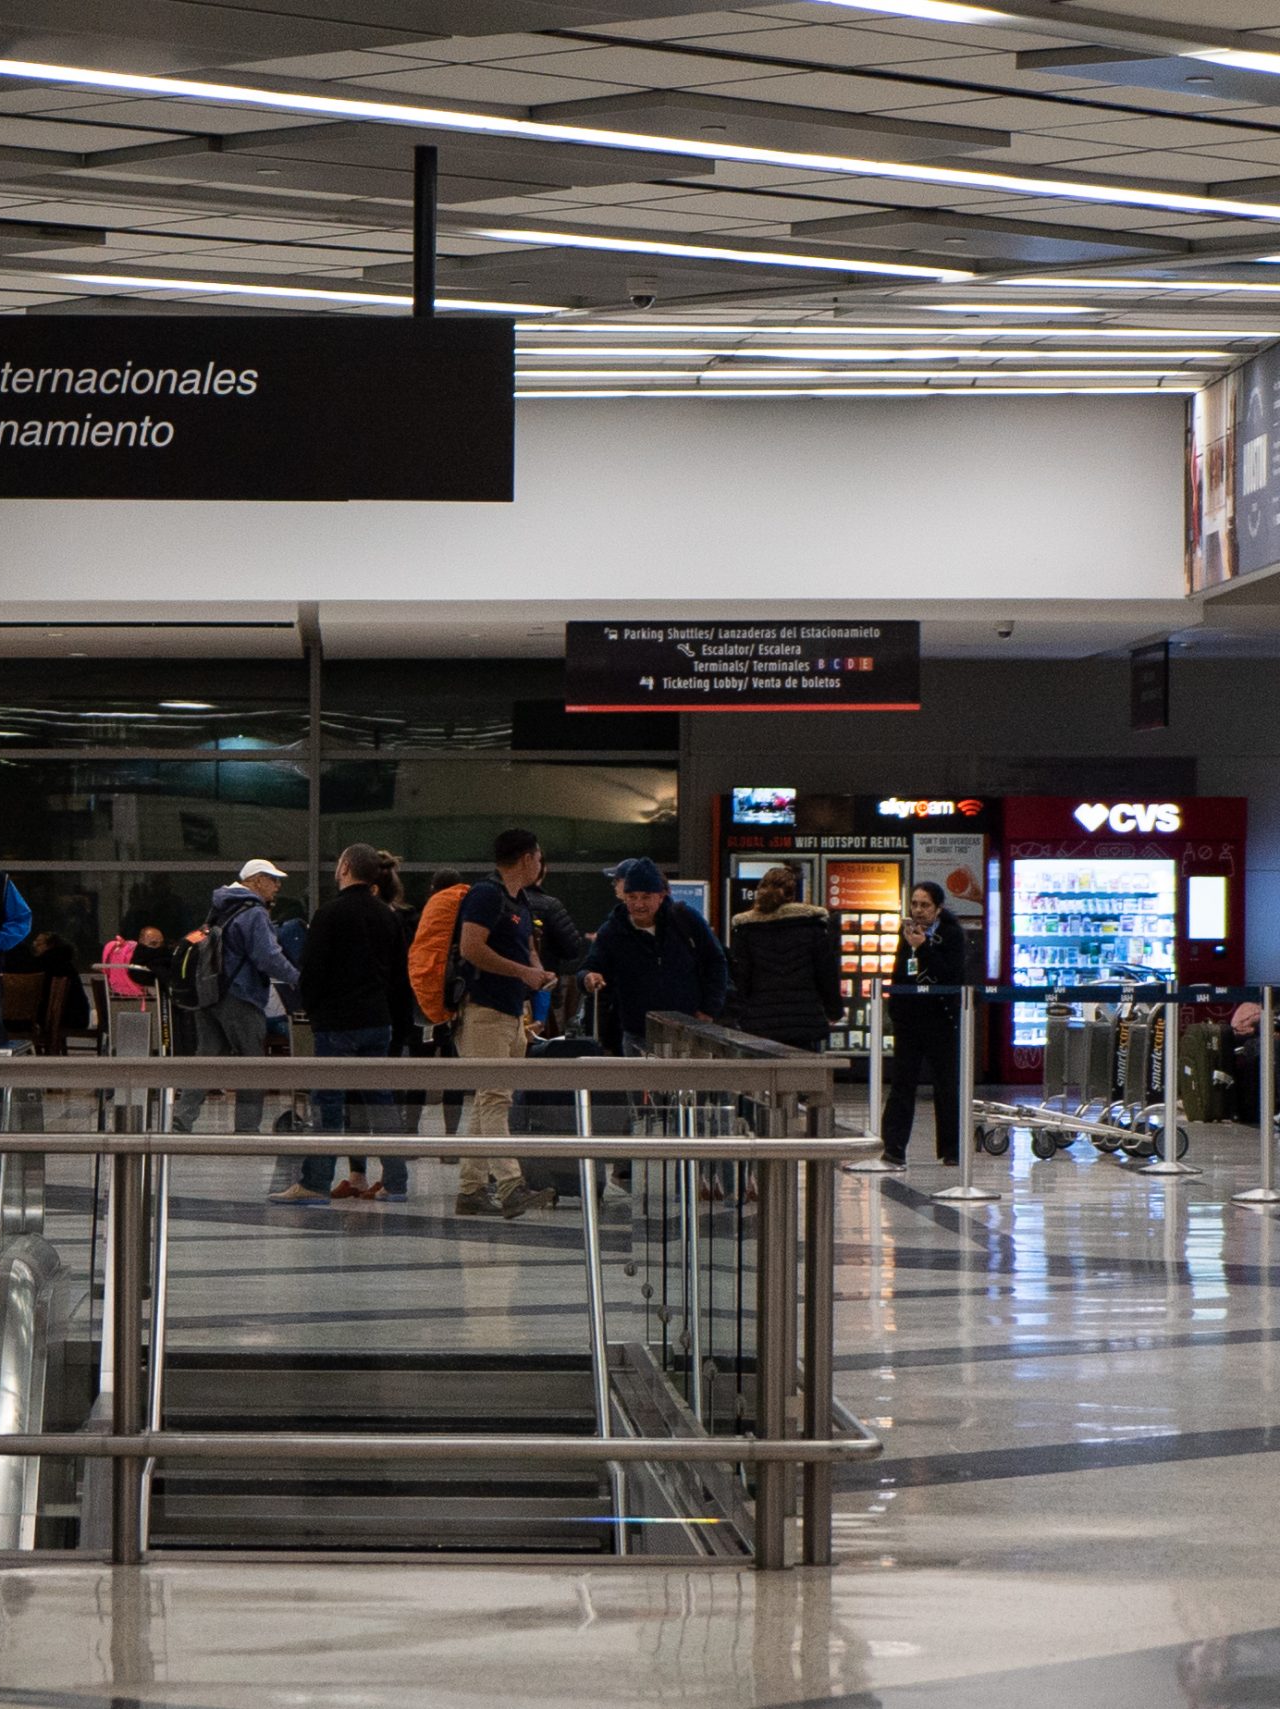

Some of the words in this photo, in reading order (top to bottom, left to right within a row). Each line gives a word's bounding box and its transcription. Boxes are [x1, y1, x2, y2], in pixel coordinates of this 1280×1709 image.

[623, 628, 664, 642] Parking
[667, 628, 715, 640] Shuttles/
[718, 627, 777, 639] Lanzaderas
[780, 627, 796, 638] del
[701, 643, 755, 657] Escalator/
[758, 643, 802, 655] Escalera
[693, 660, 750, 673] Terminals/
[752, 659, 810, 672] Terminales
[818, 659, 825, 670] B
[833, 659, 841, 670] C
[847, 659, 855, 670] D
[862, 659, 870, 670] E
[663, 677, 710, 691] Ticketing
[713, 676, 749, 691] Lobby/
[751, 677, 782, 689] Venta
[784, 677, 798, 688] de
[801, 676, 841, 689] boletos
[878, 797, 956, 819] skyroam
[1107, 802, 1182, 833] CVS
[795, 836, 818, 848] WIFI
[820, 836, 867, 848] HOTSPOT
[870, 836, 909, 848] RENTAL
